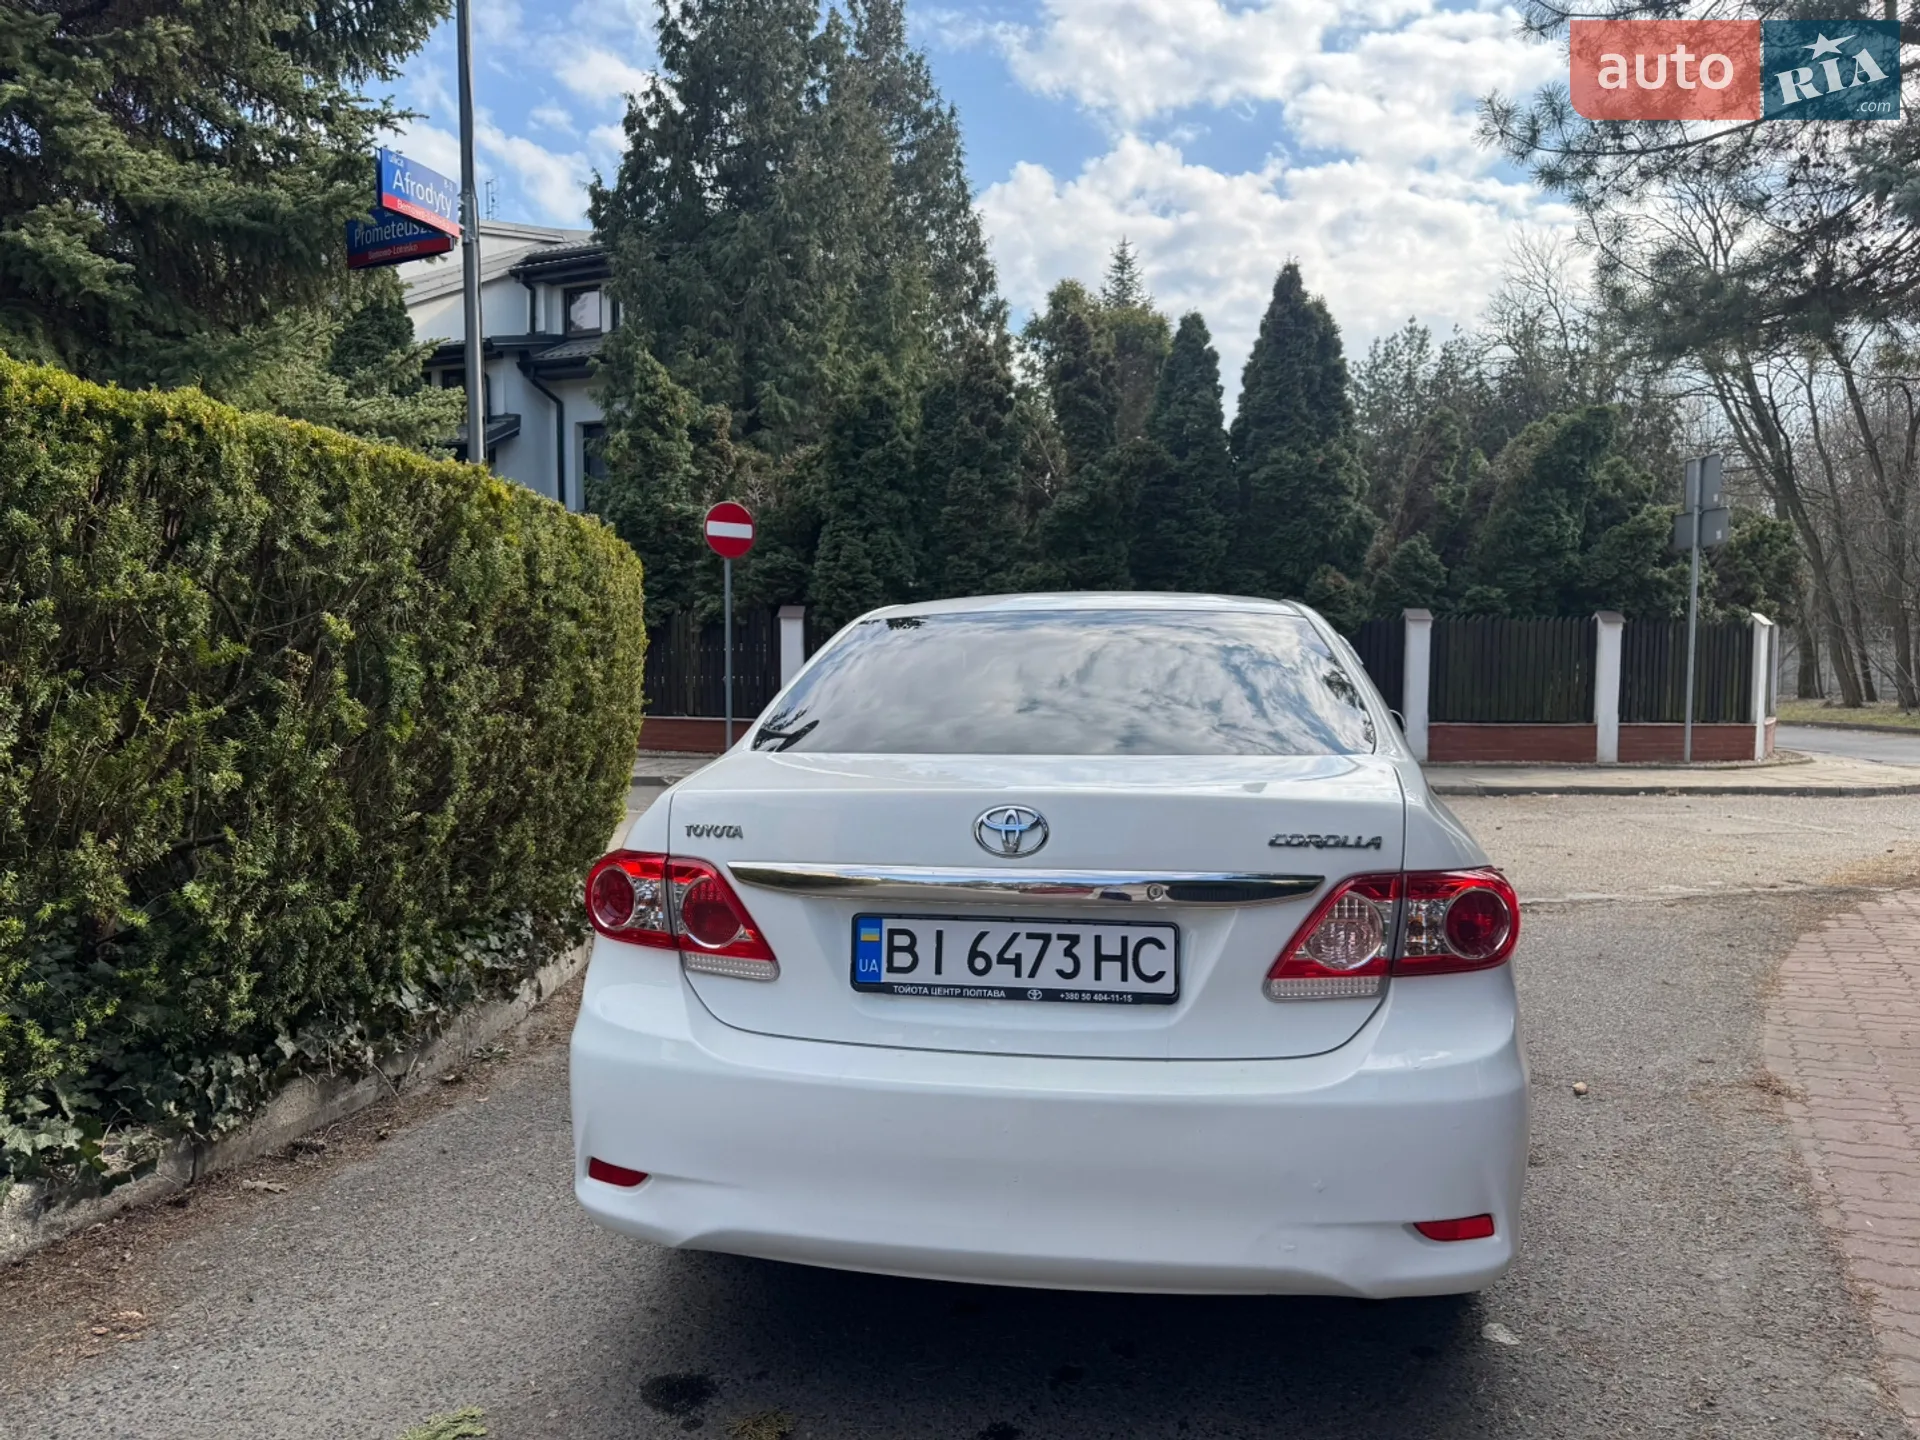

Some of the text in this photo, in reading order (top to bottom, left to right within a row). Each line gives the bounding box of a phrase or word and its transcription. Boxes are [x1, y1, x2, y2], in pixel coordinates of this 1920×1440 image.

[392, 169, 452, 219] Afrodyty
[354, 220, 433, 247] Prometeusz
[685, 824, 743, 839] TOYOTA
[1268, 833, 1382, 850] COROLLA
[886, 928, 1167, 983] BI 6473 HC
[859, 959, 879, 972] UA
[893, 985, 1006, 998] ТОЙОТА ЦЕНТР ПОЛТАВА
[1060, 992, 1079, 1000] +380
[1081, 993, 1092, 1001] 50
